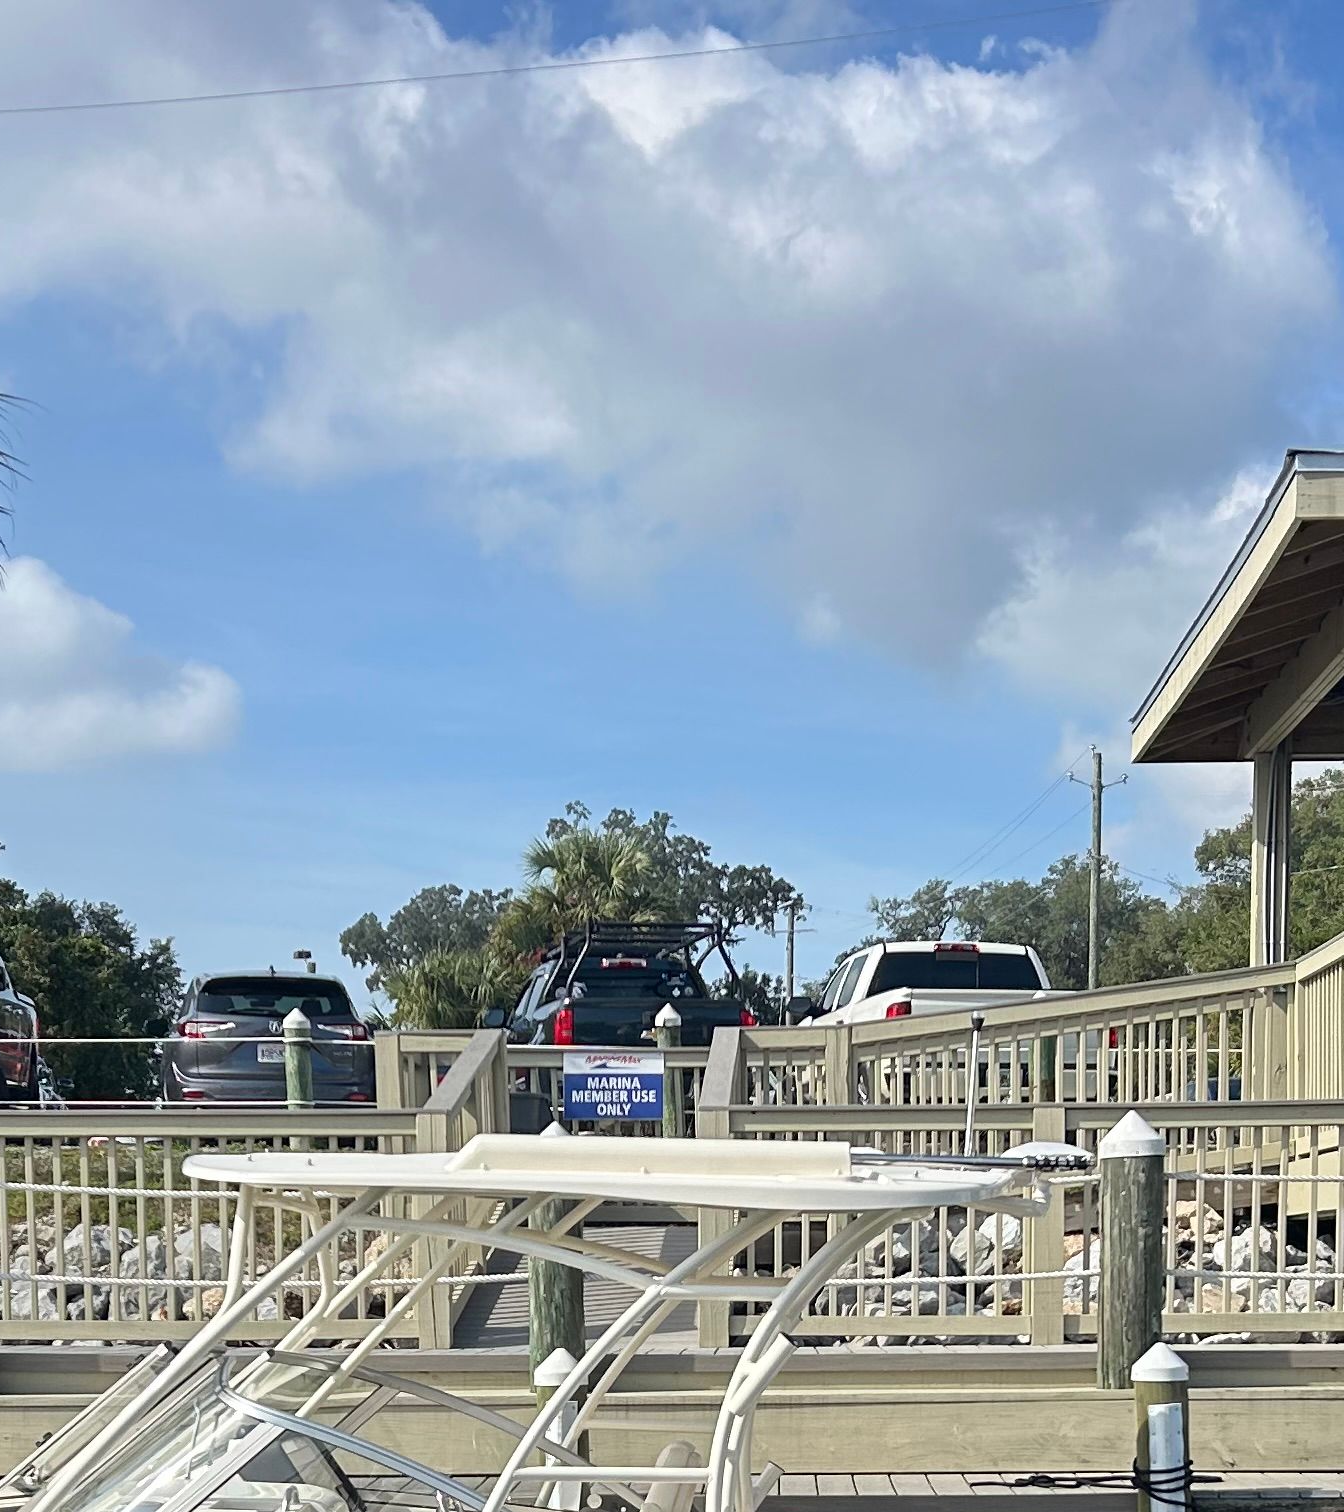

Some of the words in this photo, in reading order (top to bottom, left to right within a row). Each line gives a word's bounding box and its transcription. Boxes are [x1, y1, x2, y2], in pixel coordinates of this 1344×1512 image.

[587, 1077, 641, 1089] MARINA
[571, 1090, 628, 1103] MEMBER
[632, 1090, 656, 1103] USE
[596, 1103, 631, 1116] ONLY
